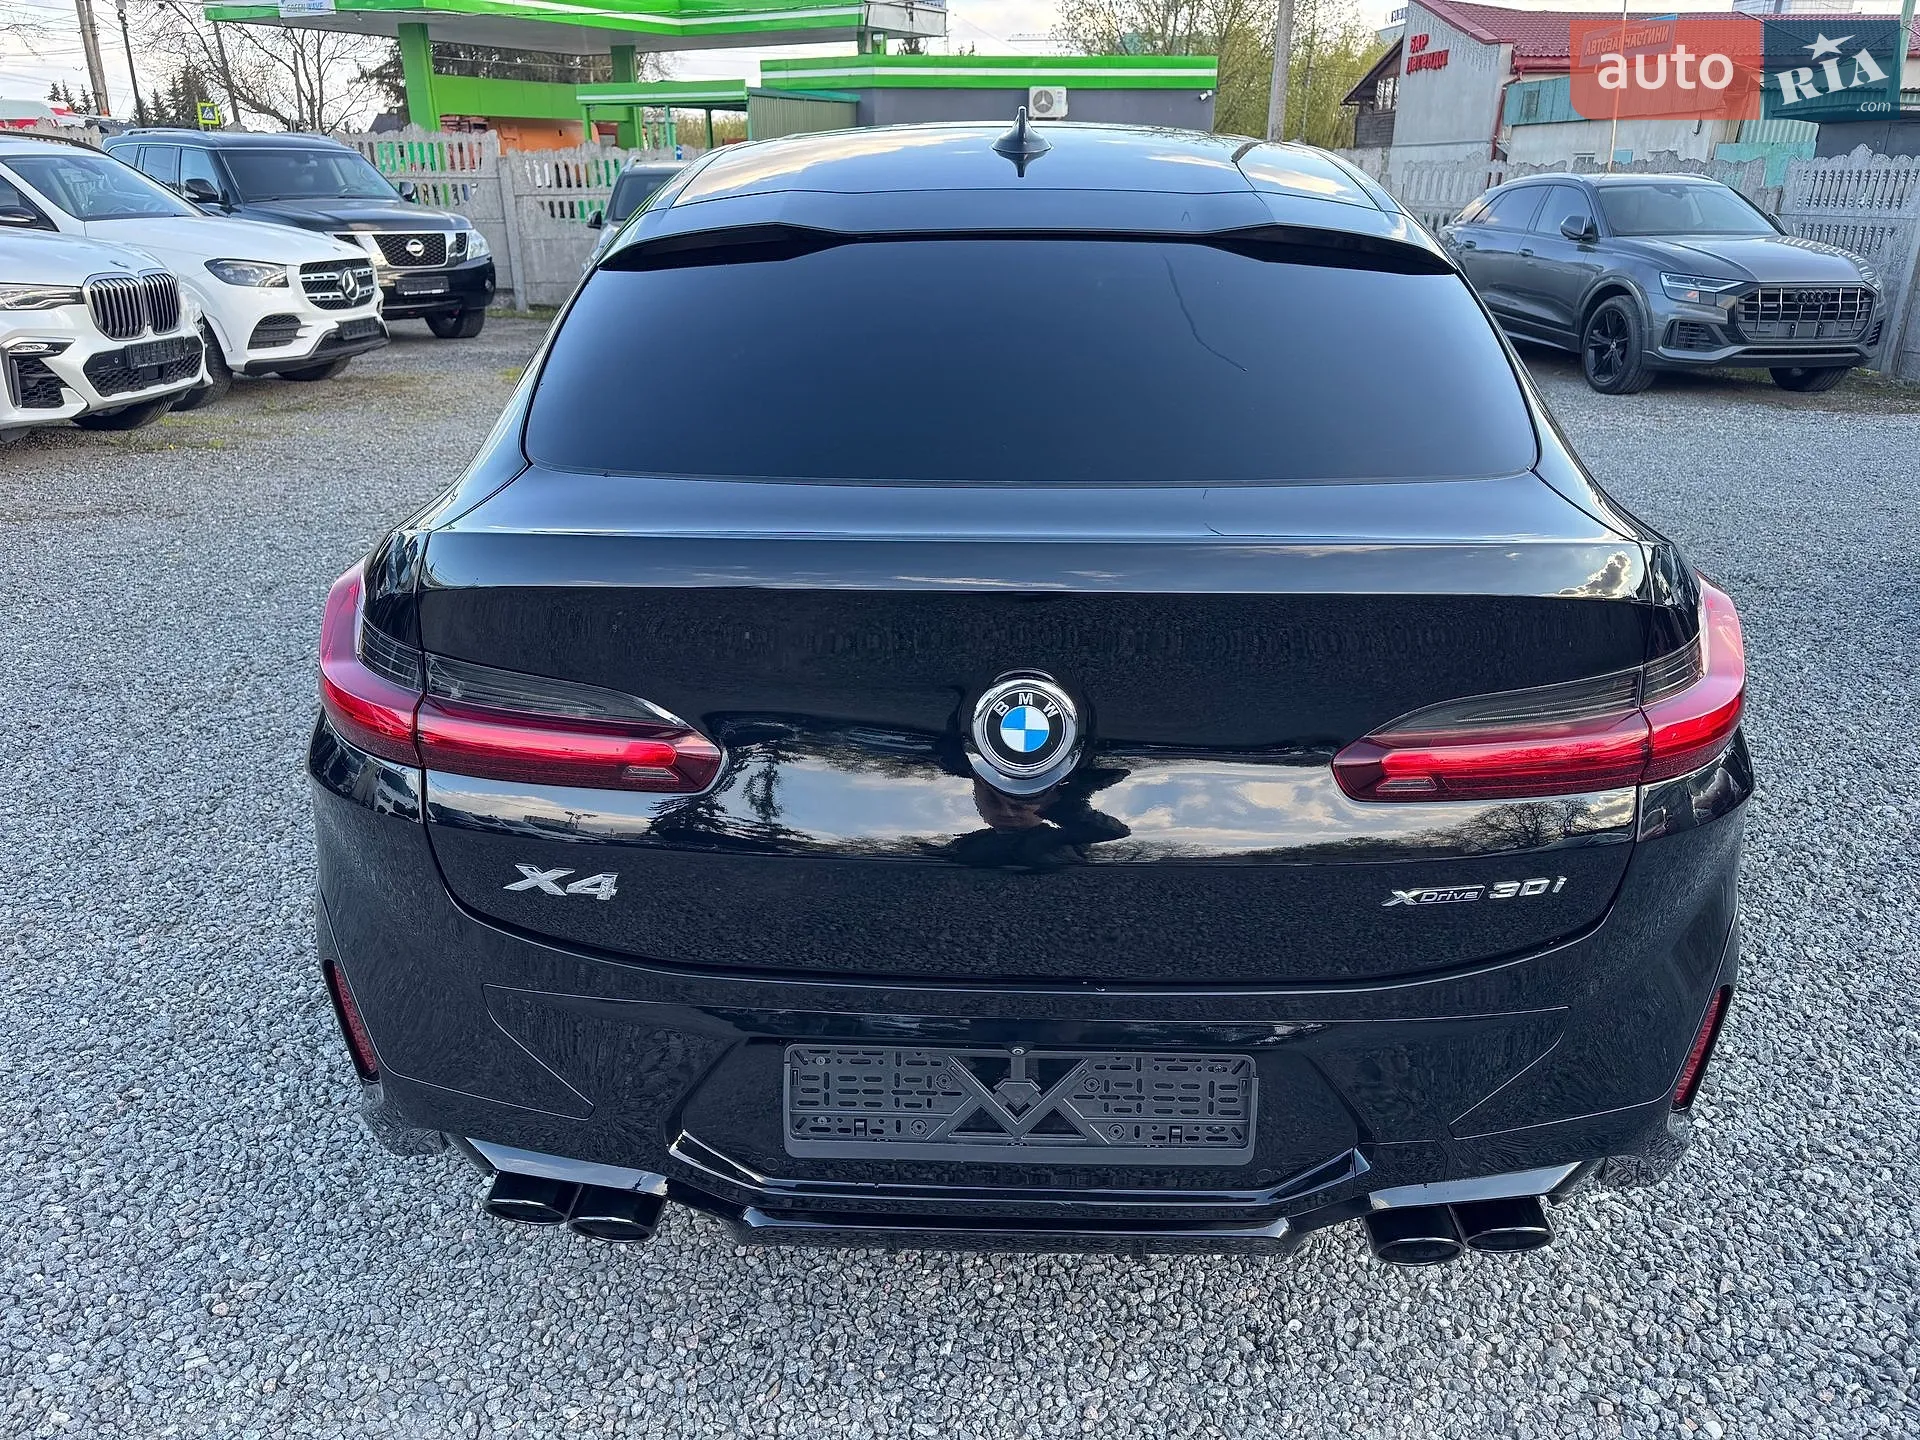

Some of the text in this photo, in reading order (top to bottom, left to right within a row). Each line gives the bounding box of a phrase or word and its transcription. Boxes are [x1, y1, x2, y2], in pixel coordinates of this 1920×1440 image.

[1410, 34, 1429, 53] БАР
[993, 693, 1060, 718] BMW
[503, 863, 618, 900] X4
